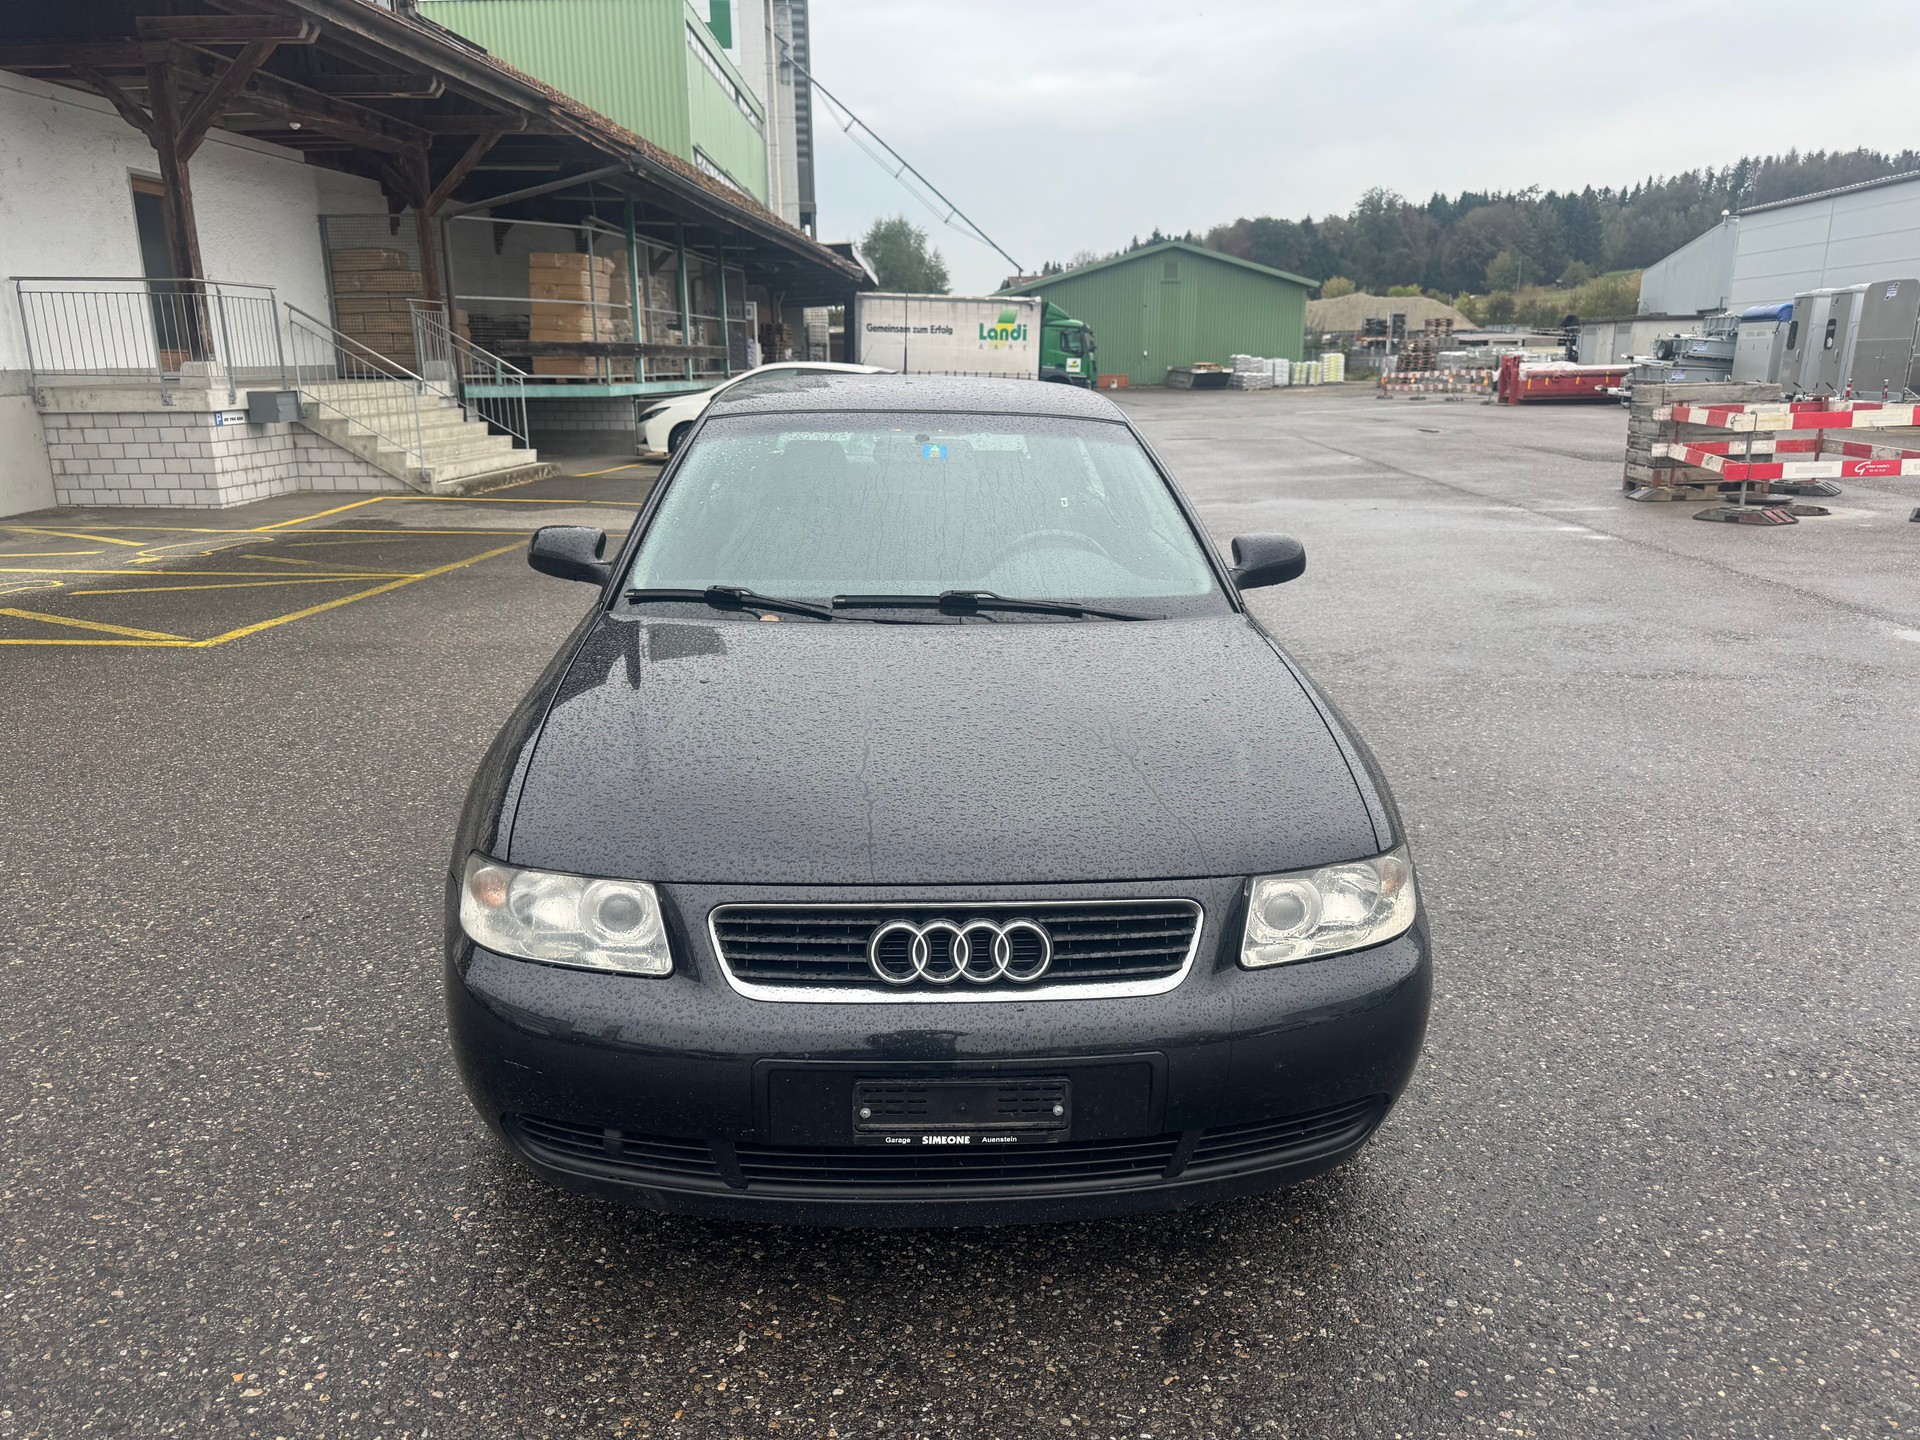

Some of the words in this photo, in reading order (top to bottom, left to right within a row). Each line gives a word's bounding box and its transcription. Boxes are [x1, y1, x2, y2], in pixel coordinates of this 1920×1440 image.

[866, 323, 911, 333] Gemeinsam
[912, 326, 928, 334] zum
[930, 325, 953, 335] Erfolg
[979, 322, 1027, 341] Landi
[885, 1136, 911, 1144] Garage
[922, 1136, 970, 1144] SIMEONE
